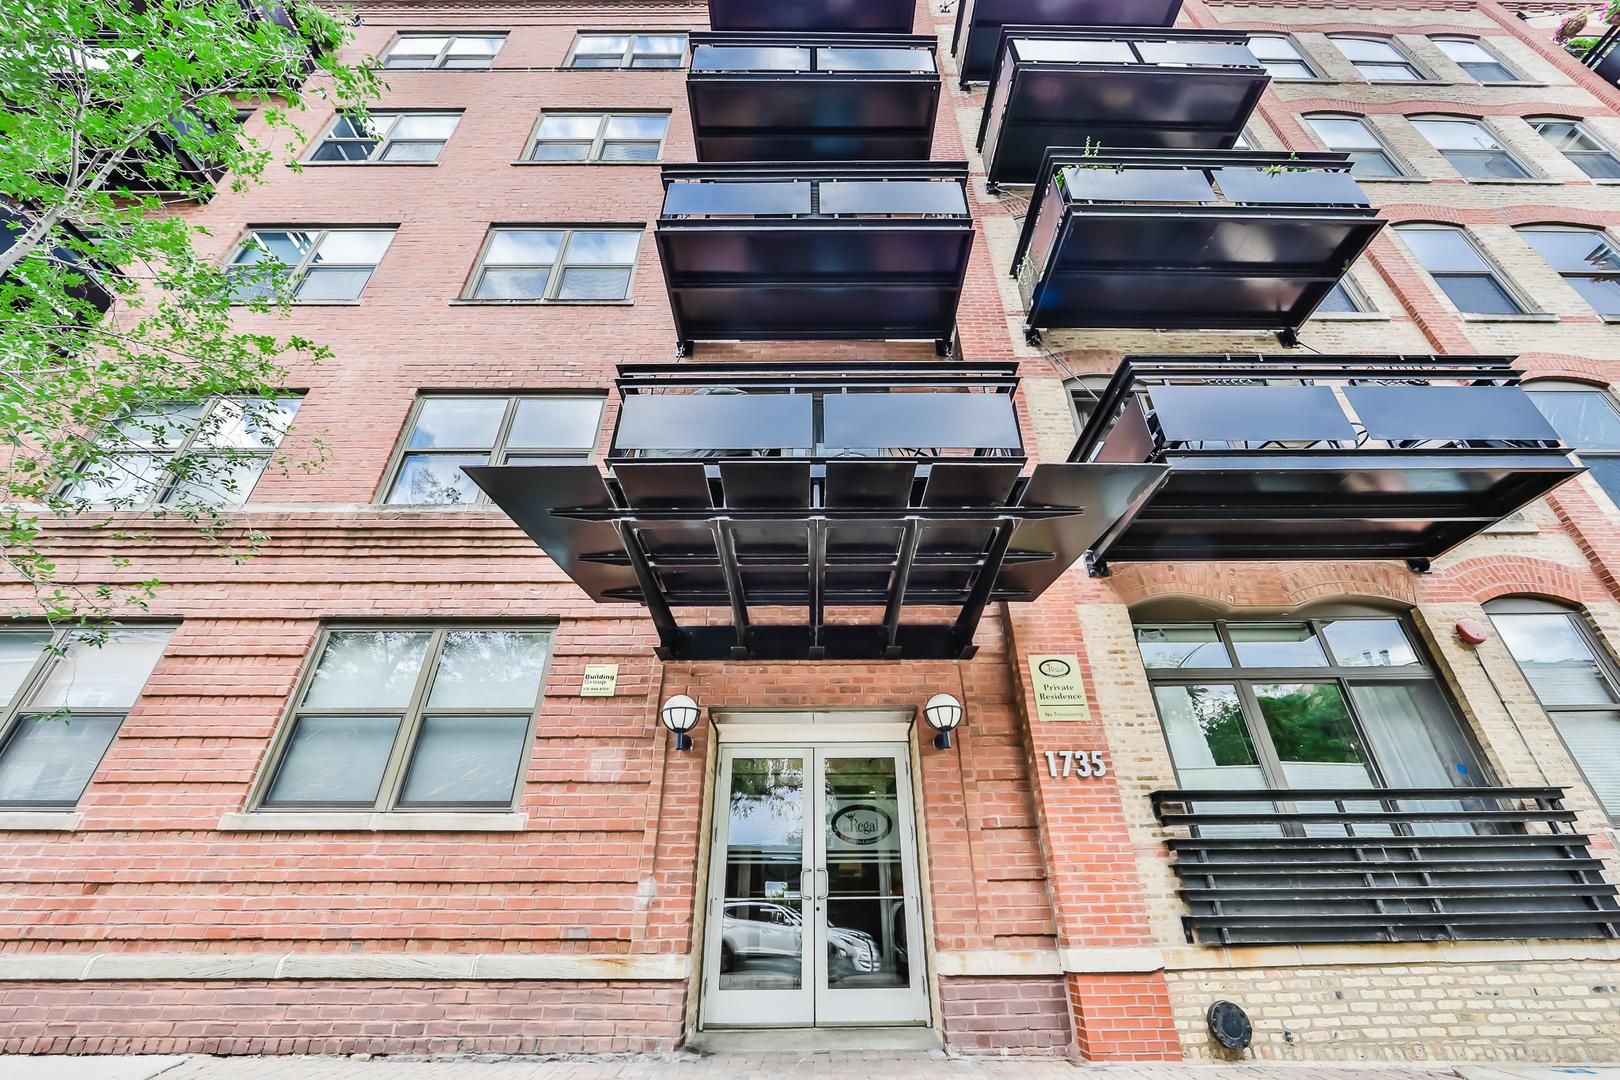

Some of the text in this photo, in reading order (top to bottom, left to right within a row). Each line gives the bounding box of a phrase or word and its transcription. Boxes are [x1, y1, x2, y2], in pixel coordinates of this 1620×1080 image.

[1043, 683, 1074, 691] Private
[1044, 750, 1107, 777] 1735
[849, 817, 879, 835] Regal
